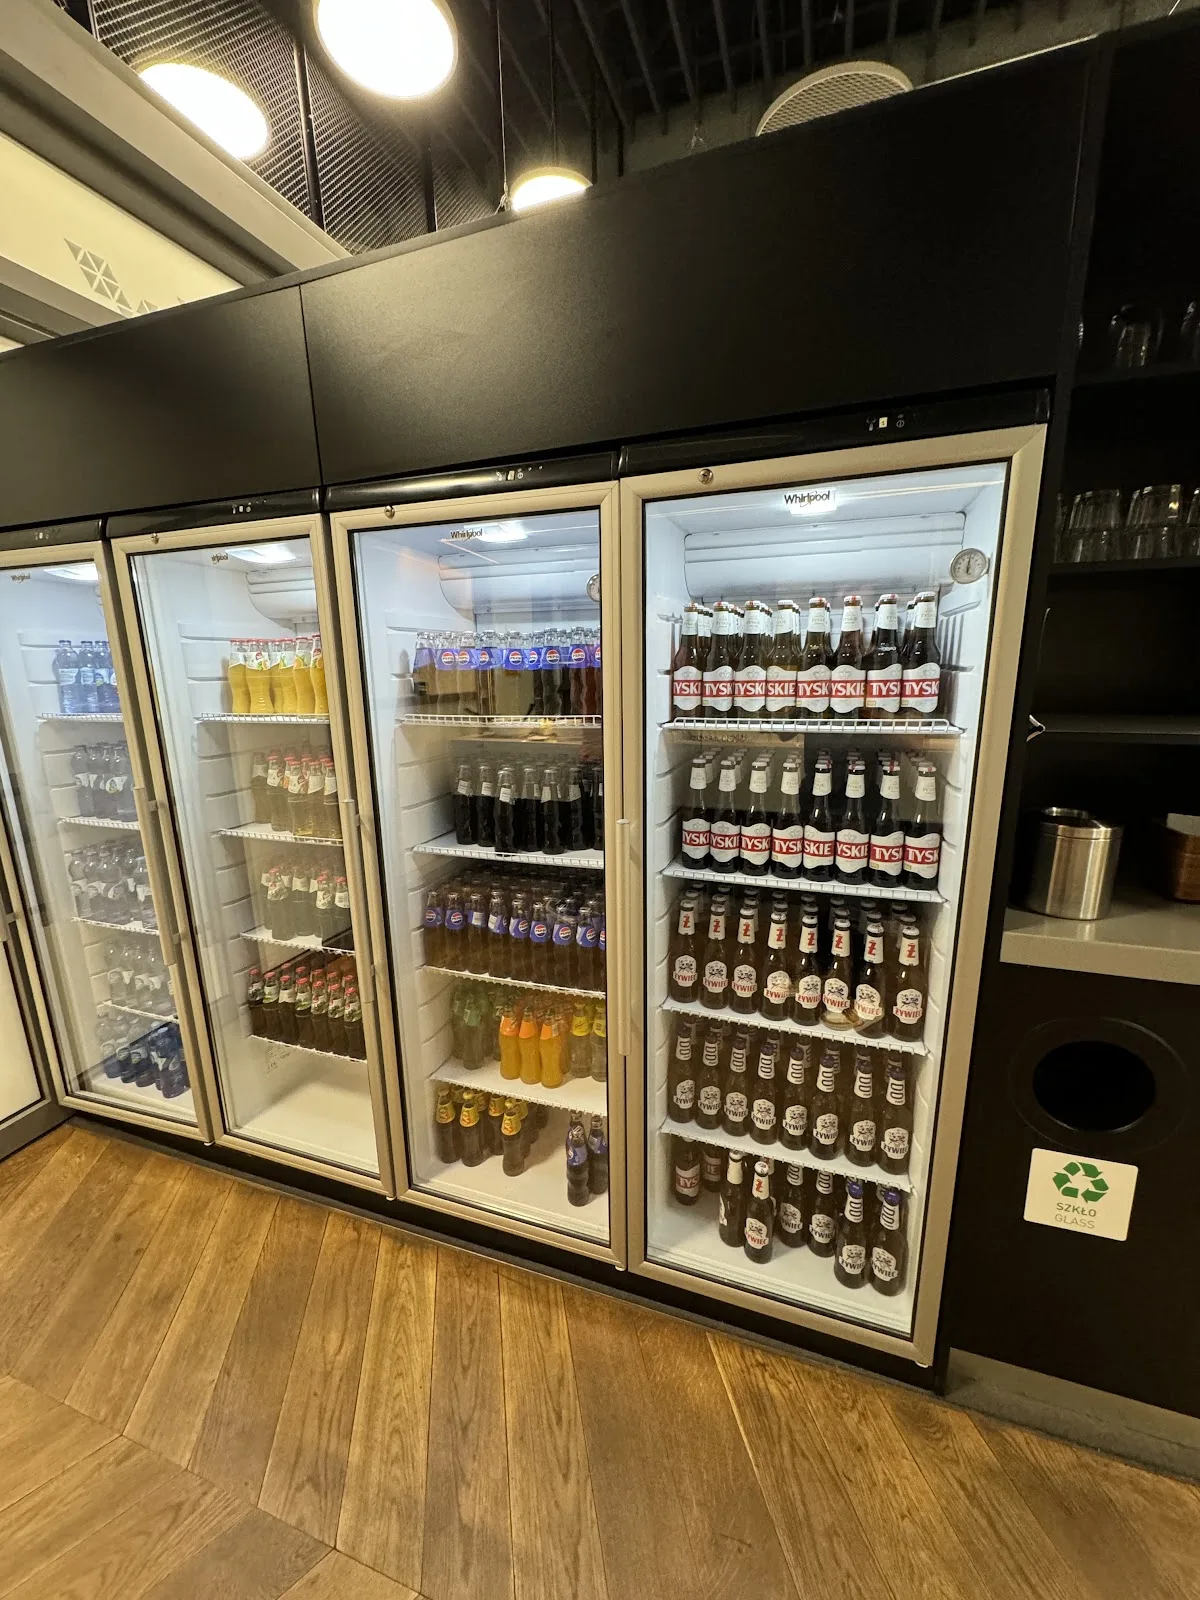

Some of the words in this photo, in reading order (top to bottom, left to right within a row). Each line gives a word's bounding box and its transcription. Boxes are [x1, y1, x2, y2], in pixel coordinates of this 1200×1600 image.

[784, 490, 830, 506] Whirlpool
[450, 528, 482, 541] Whirlpool
[767, 682, 796, 695] SKIE
[1055, 1202, 1097, 1218] SZKŁO
[1054, 1213, 1096, 1229] GLASS
